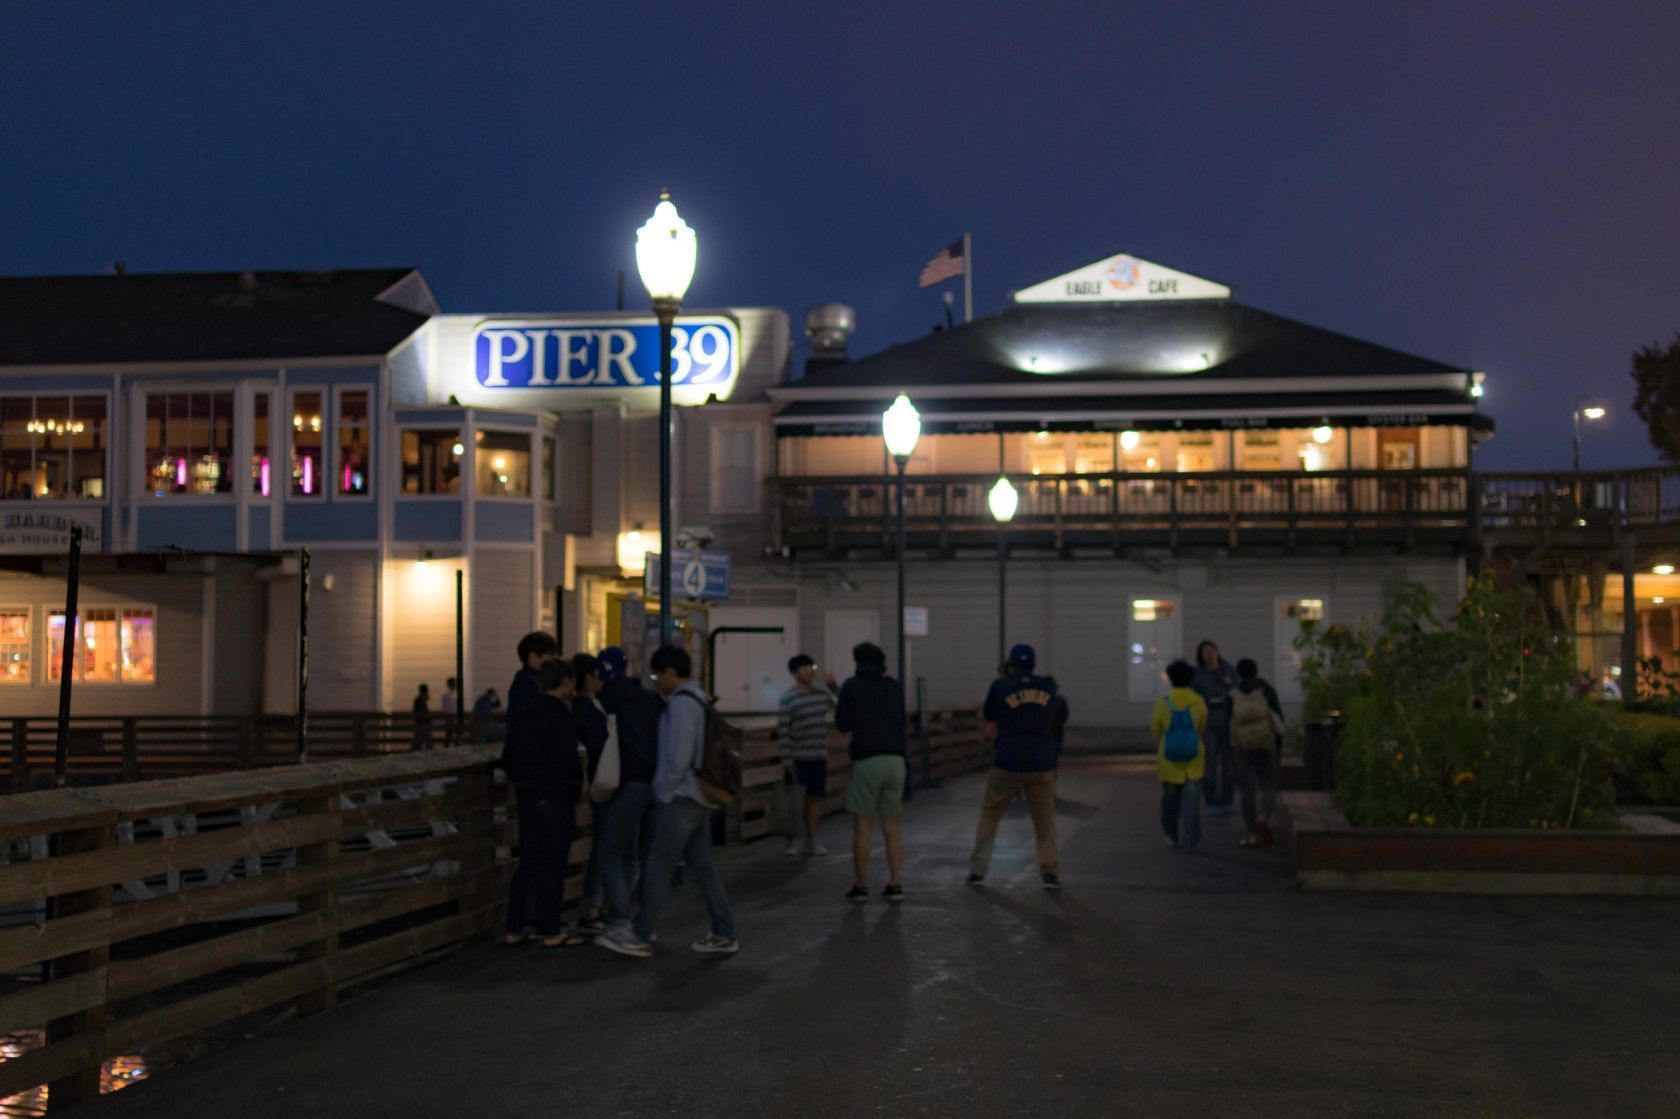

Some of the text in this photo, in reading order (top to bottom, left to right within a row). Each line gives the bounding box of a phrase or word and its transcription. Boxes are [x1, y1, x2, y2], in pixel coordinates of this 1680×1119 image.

[1066, 279, 1178, 295] EAGLE CAFE
[482, 325, 730, 386] PIER 39
[687, 565, 700, 592] 4
